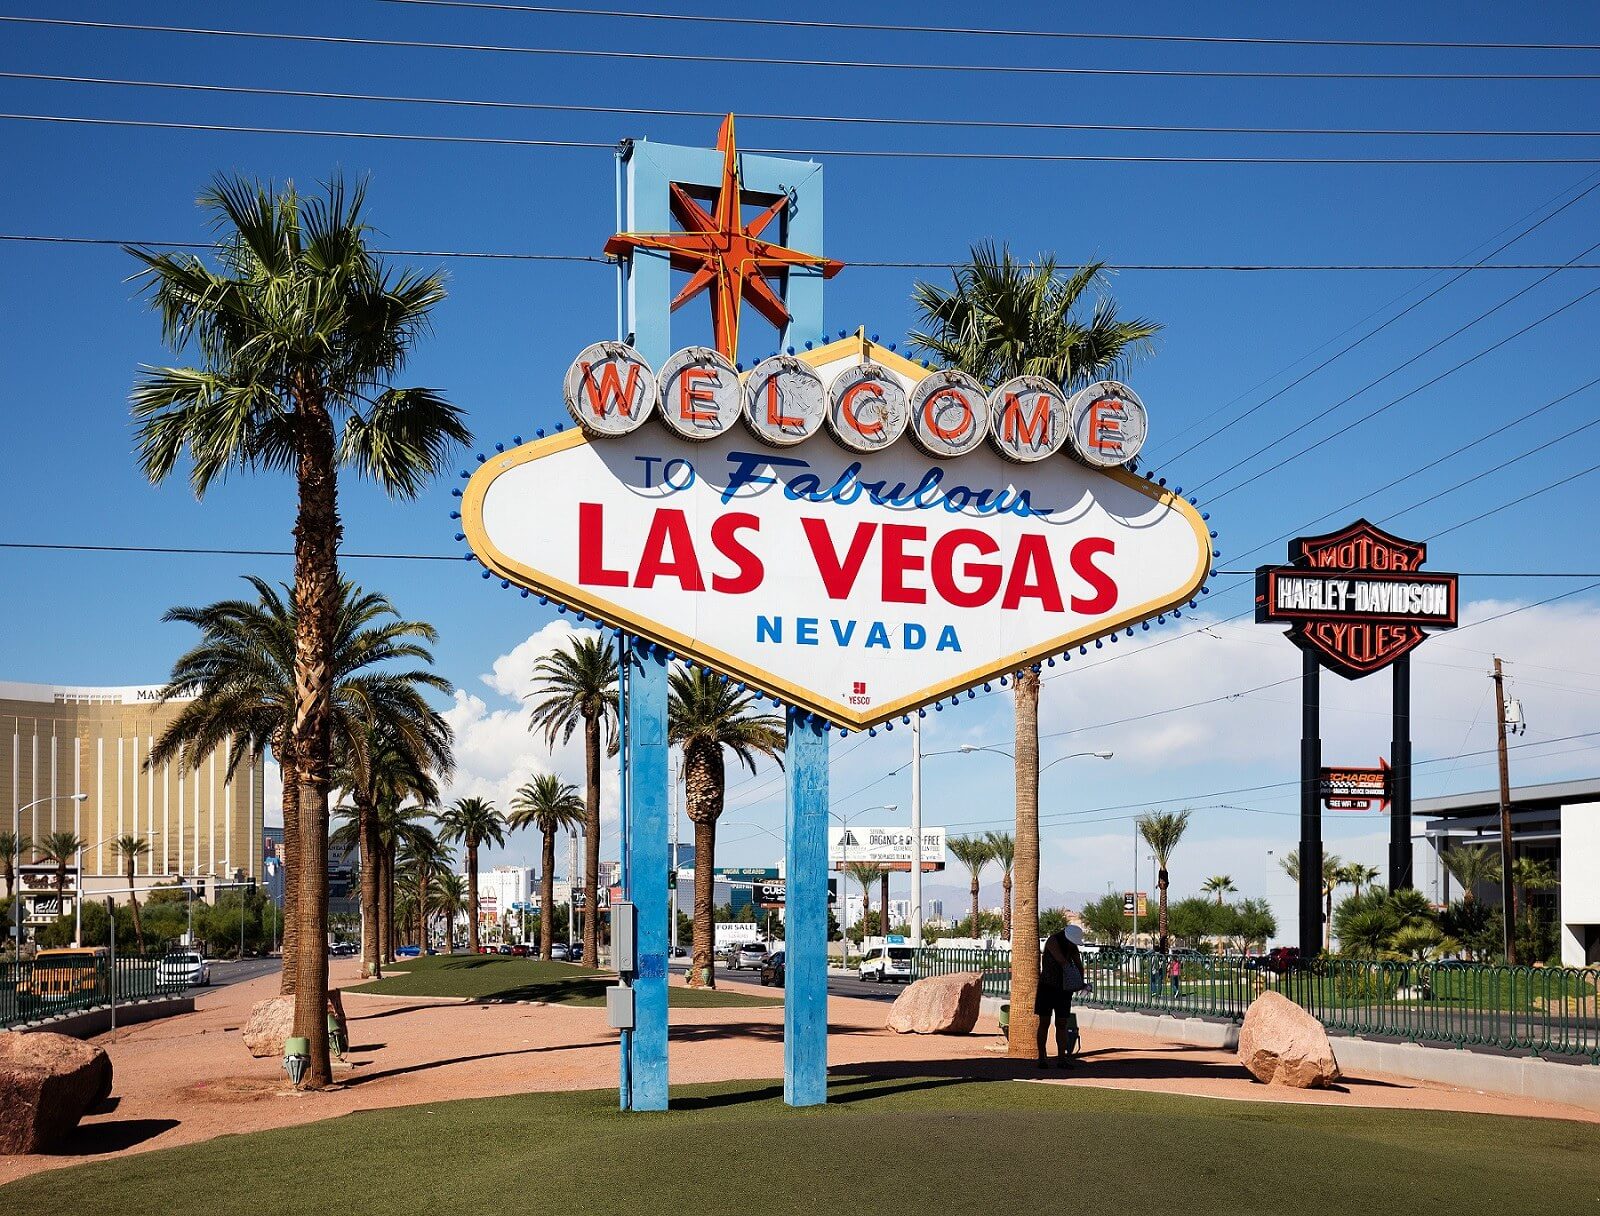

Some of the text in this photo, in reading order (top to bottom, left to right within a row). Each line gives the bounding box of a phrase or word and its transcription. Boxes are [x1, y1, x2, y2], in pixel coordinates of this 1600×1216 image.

[574, 358, 1125, 451] WELCOME
[634, 451, 1054, 517] TO Fabulous
[579, 502, 1119, 615] LAS VEGAS
[1317, 533, 1410, 571] MOTOR
[1277, 576, 1449, 616] HARLEY-DAVIDSON
[756, 615, 963, 653] NEVADA
[1316, 622, 1407, 663] CYCLES
[849, 696, 871, 705] YESCO
[869, 834, 898, 845] ORGANIC
